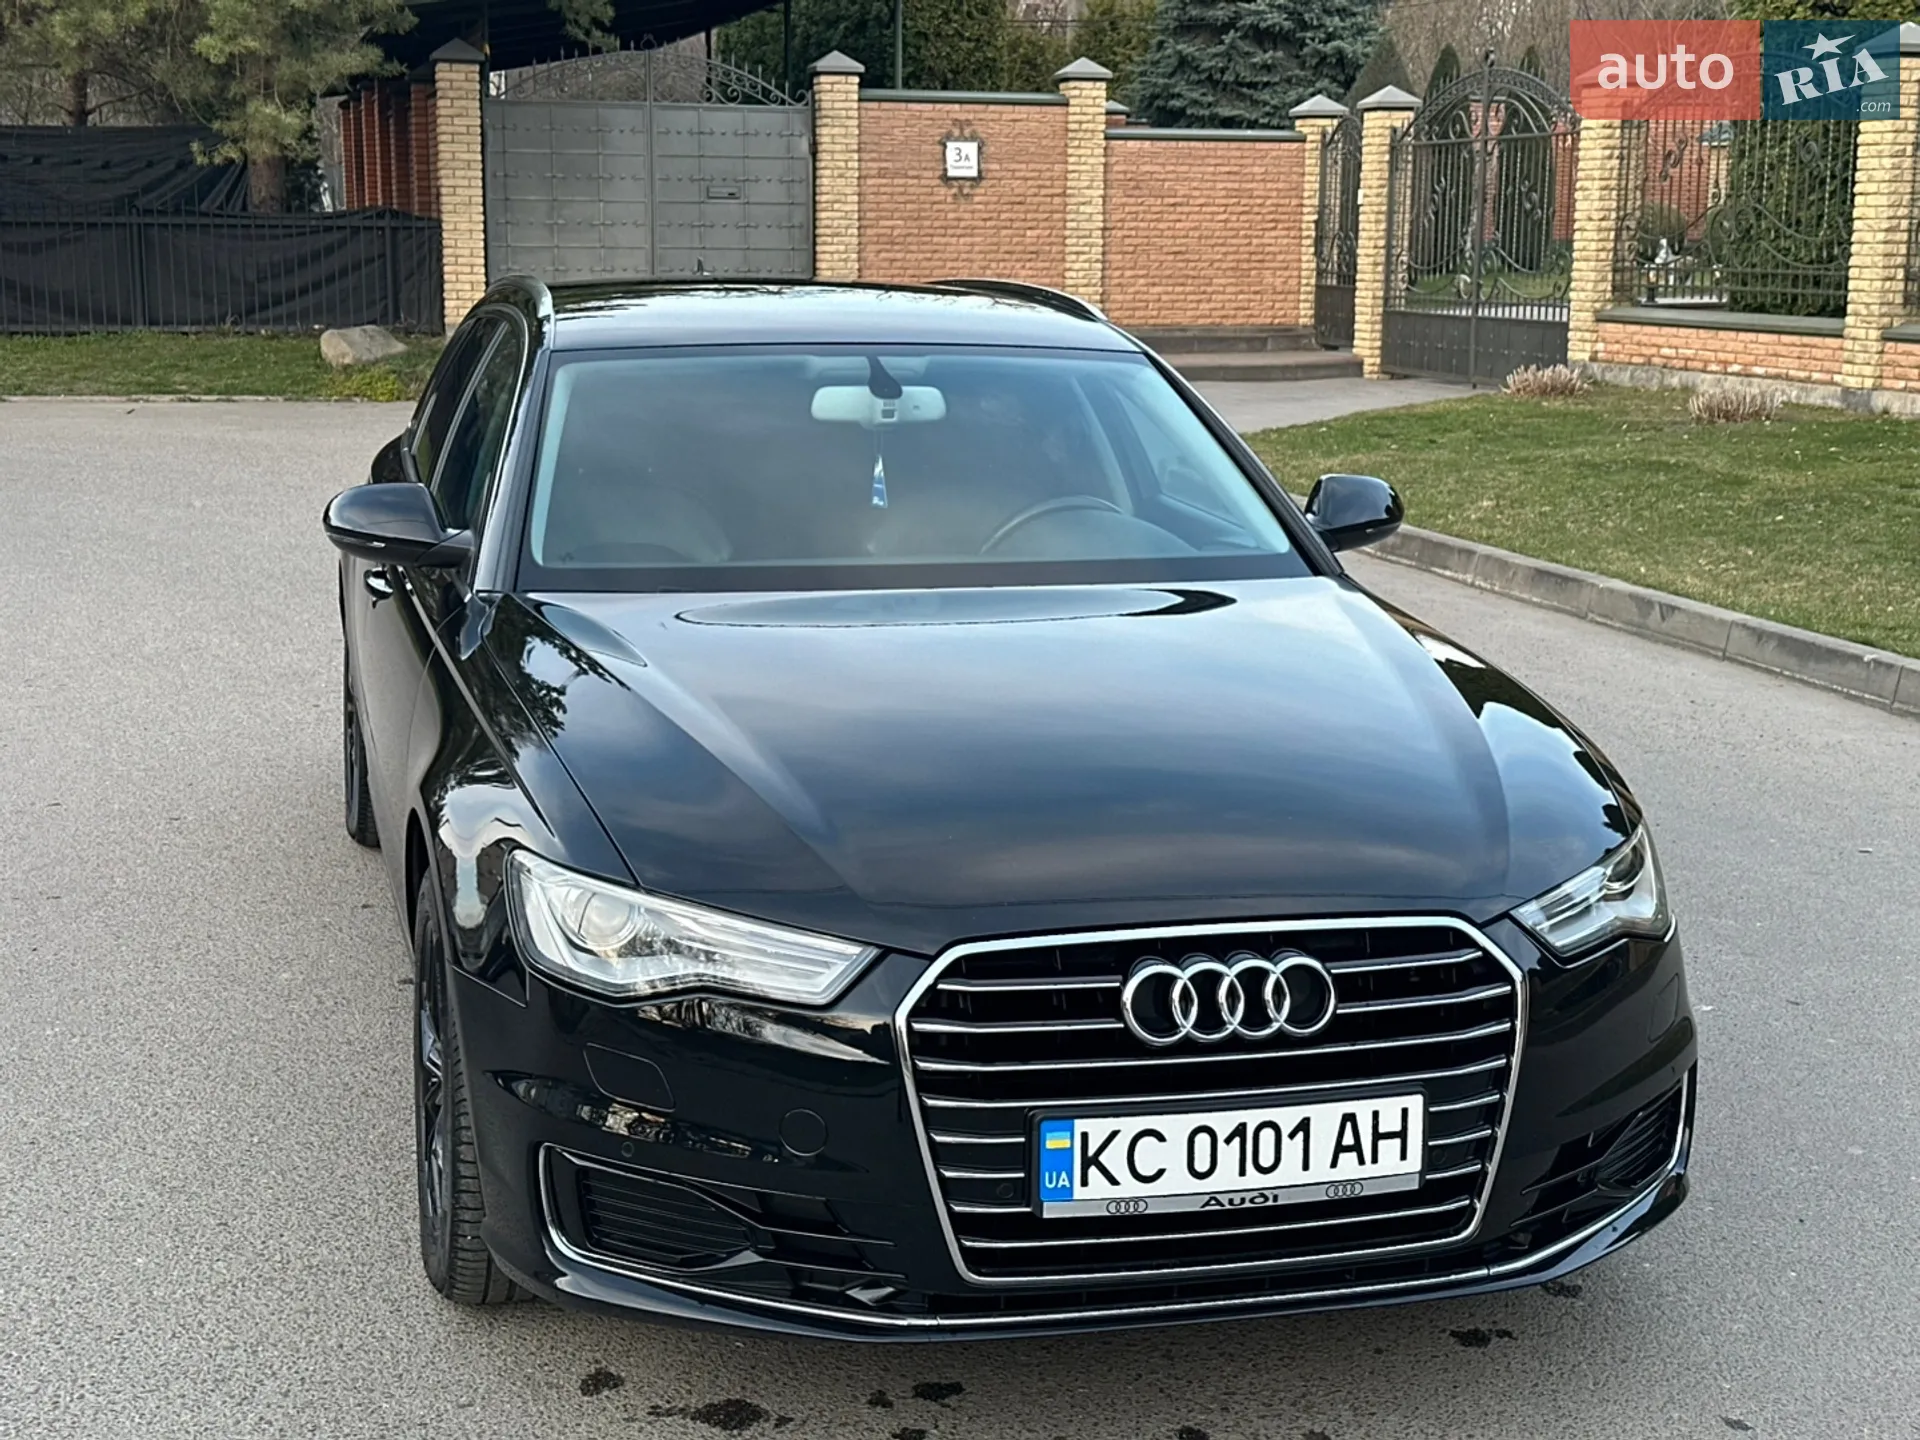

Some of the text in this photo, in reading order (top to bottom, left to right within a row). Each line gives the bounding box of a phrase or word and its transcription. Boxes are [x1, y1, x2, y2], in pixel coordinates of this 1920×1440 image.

[1080, 1107, 1409, 1187] KC 0101 AH
[1045, 1171, 1070, 1189] UA
[1199, 1192, 1279, 1209] Audi
